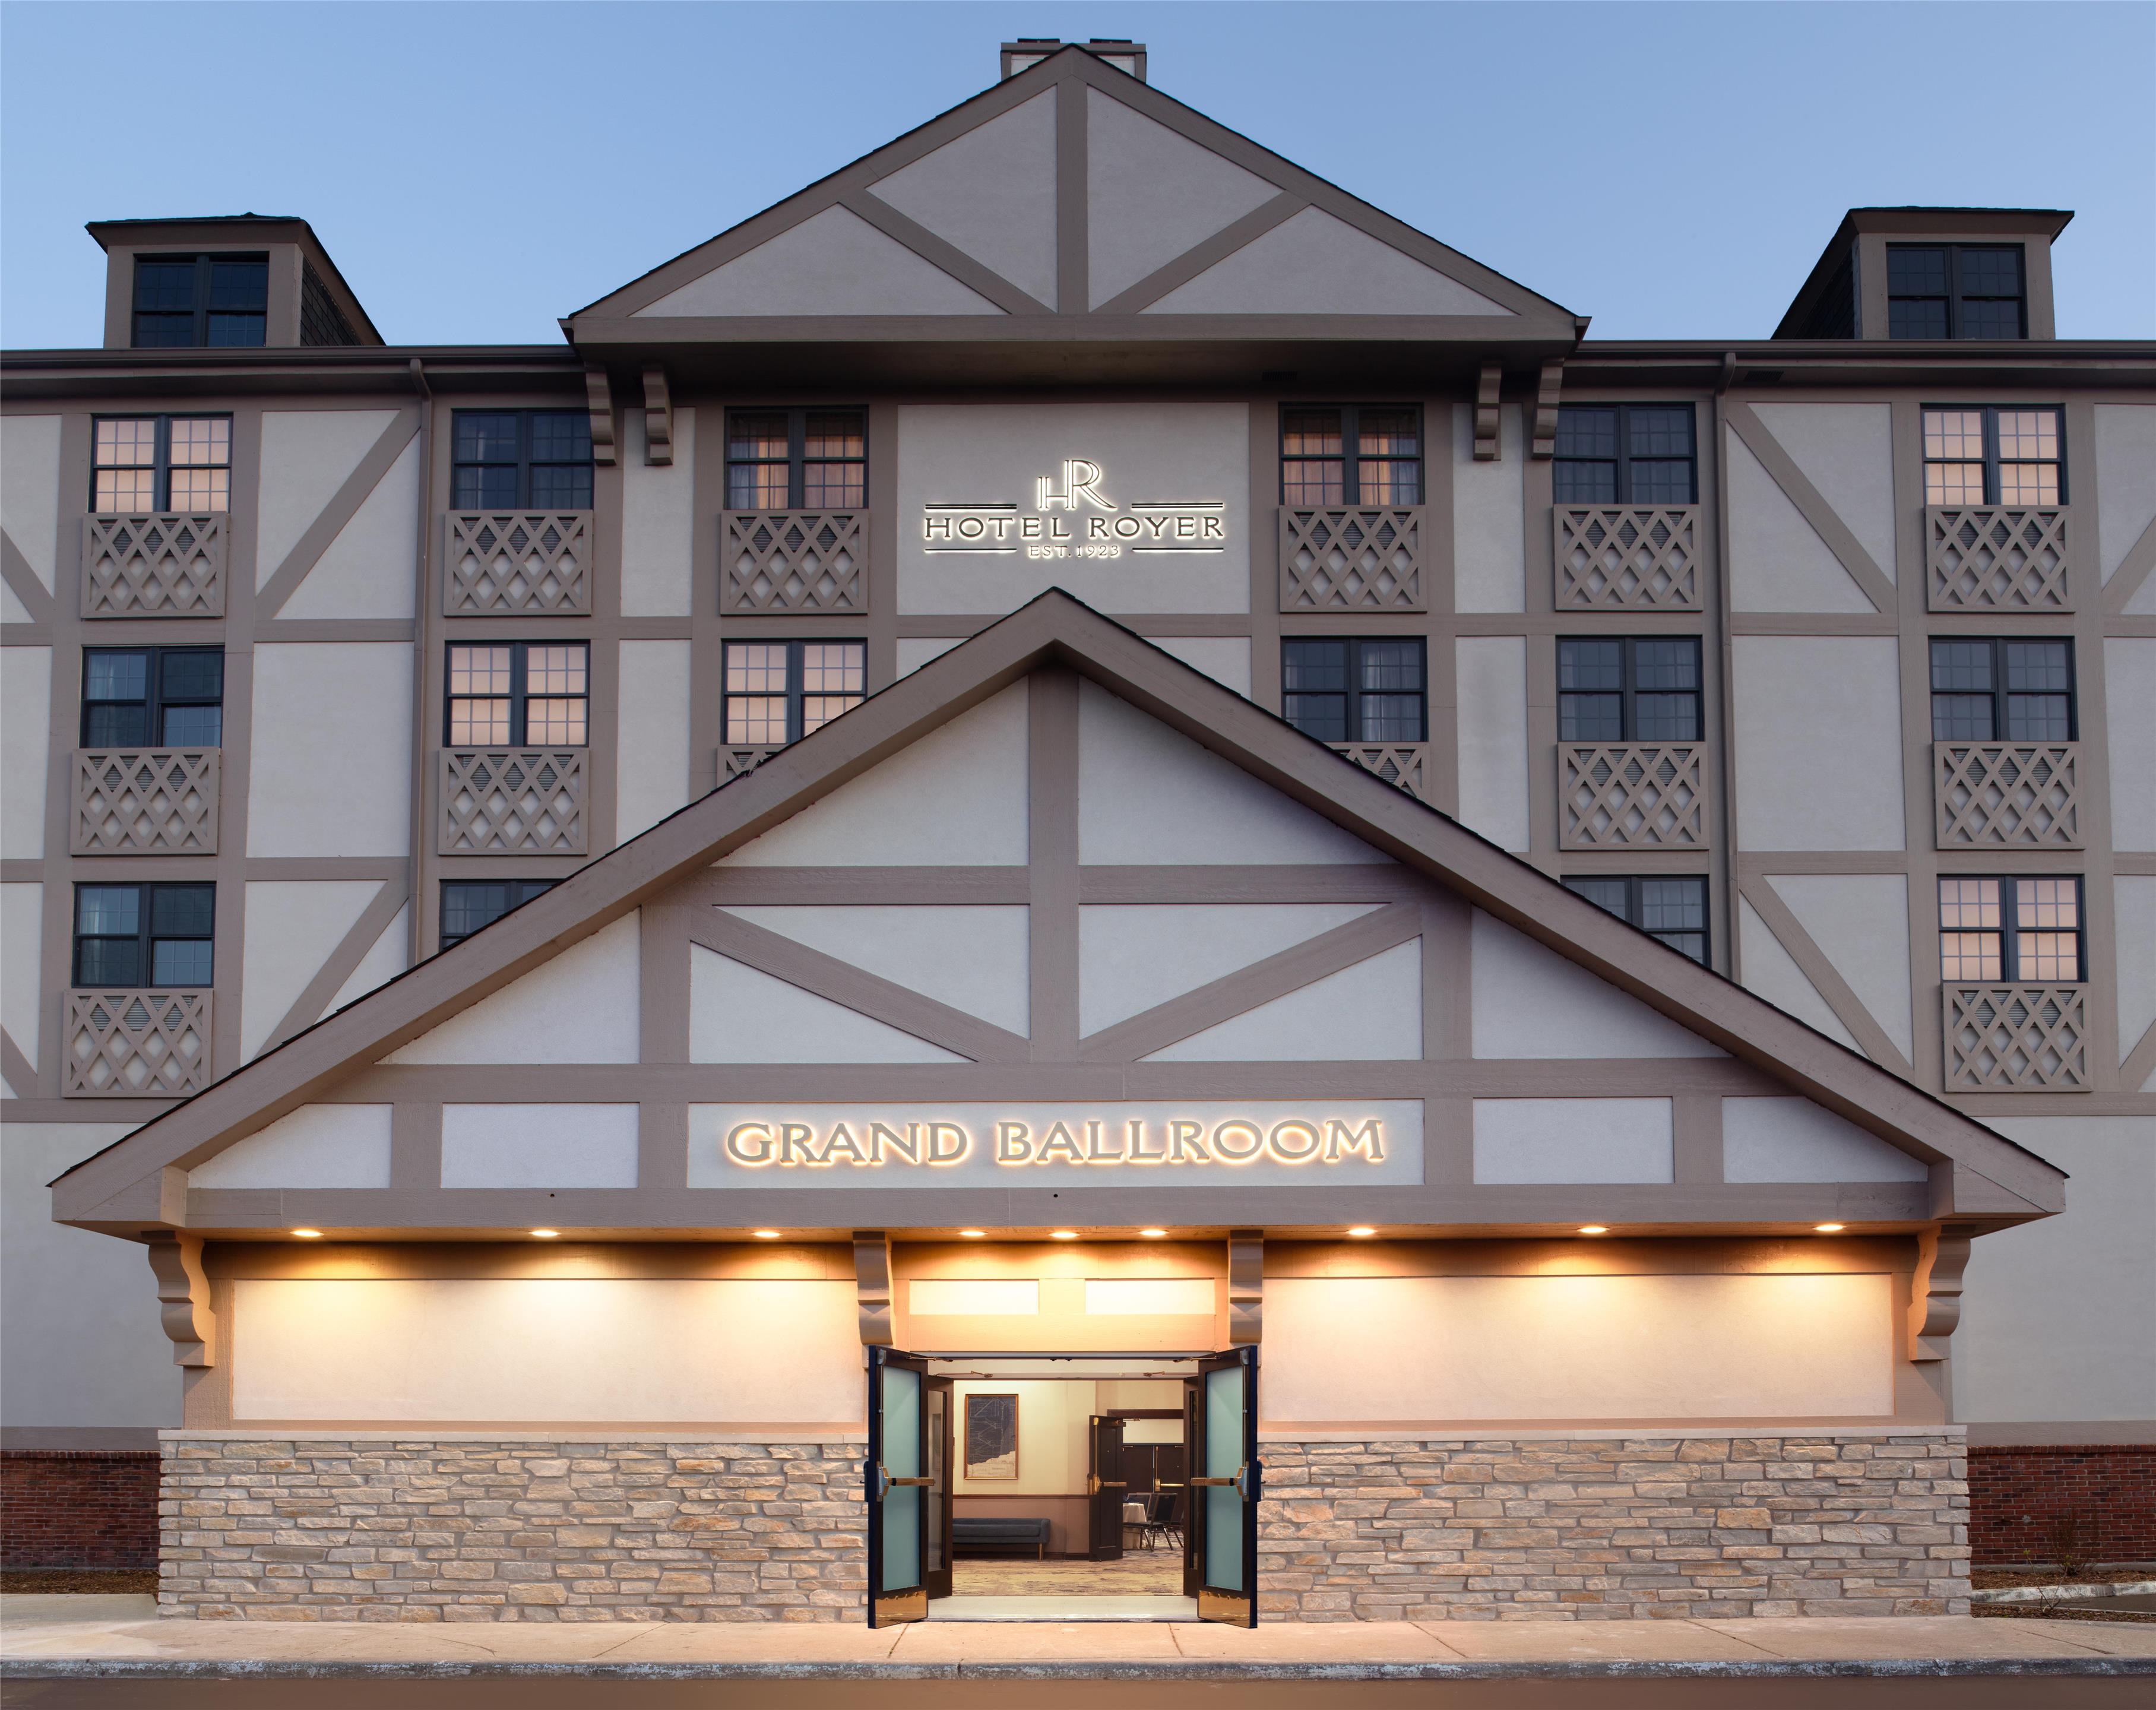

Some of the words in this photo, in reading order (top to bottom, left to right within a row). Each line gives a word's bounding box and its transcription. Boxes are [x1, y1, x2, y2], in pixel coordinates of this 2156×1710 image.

[925, 517, 1071, 539] HOTEL
[1089, 516, 1224, 538] ROYER
[726, 1122, 968, 1165] GRAND
[998, 1119, 1384, 1164] BALLROOM
